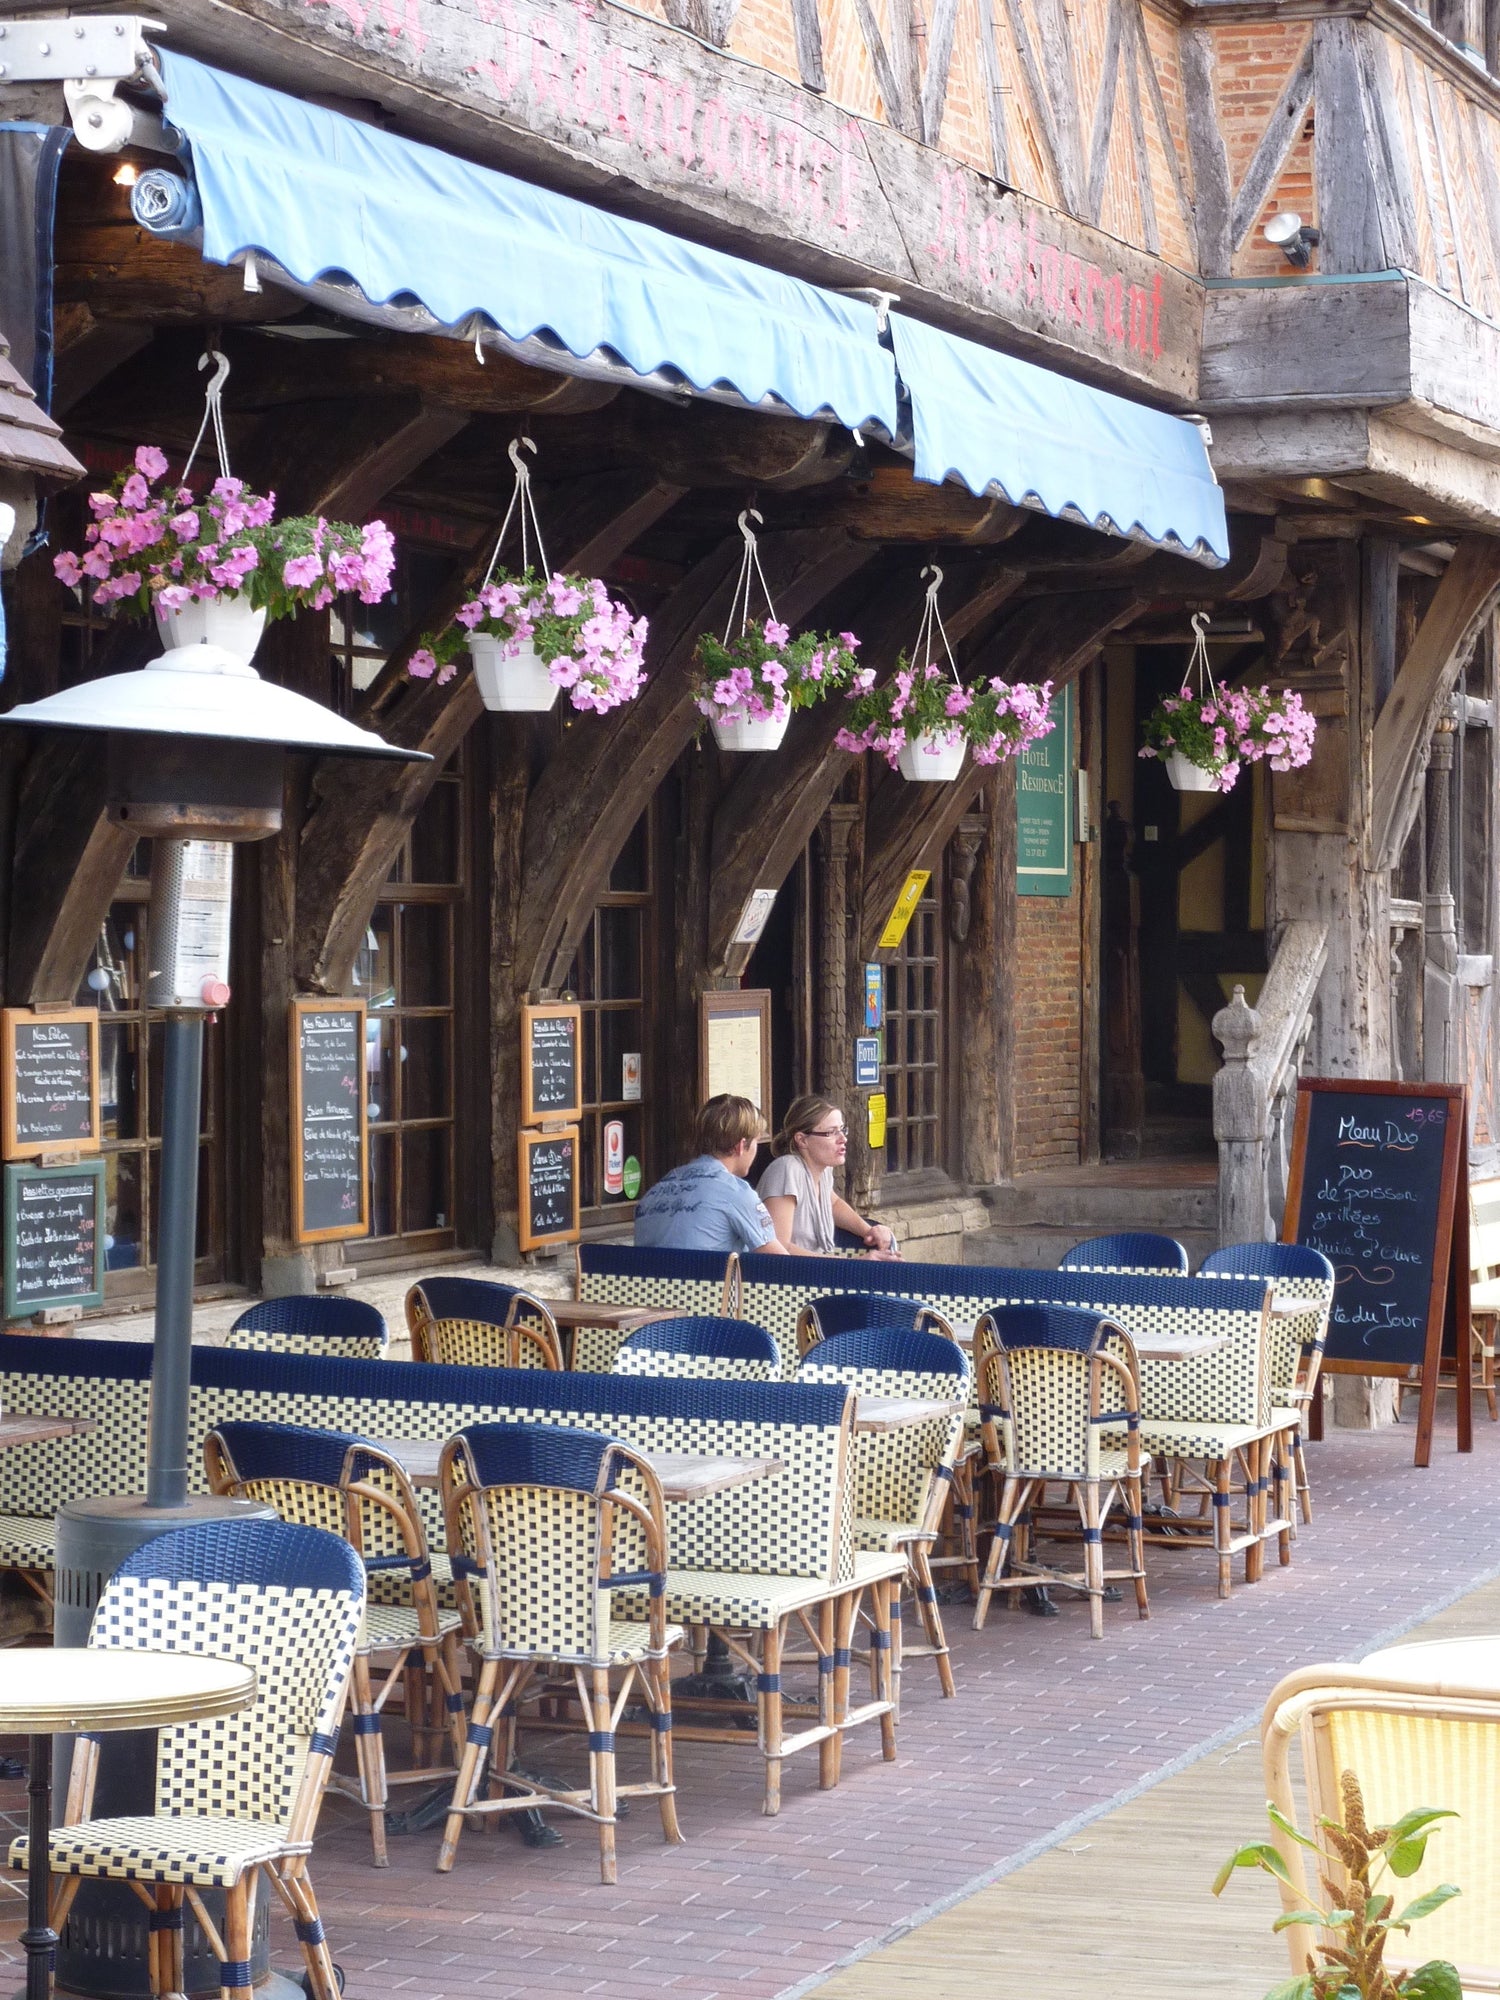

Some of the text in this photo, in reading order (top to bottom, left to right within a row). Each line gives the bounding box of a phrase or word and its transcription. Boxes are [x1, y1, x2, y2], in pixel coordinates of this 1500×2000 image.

[924, 168, 1163, 363] Restaurant
[33, 1028, 46, 1041] Nos
[858, 1043, 877, 1062] HOTEL
[1338, 1115, 1419, 1149] Menu Duo
[1338, 1165, 1373, 1186] Duo
[1317, 1179, 1339, 1203] de
[1354, 1225, 1368, 1240] à
[1352, 1305, 1379, 1323] du
[1363, 1302, 1423, 1346] Jour
